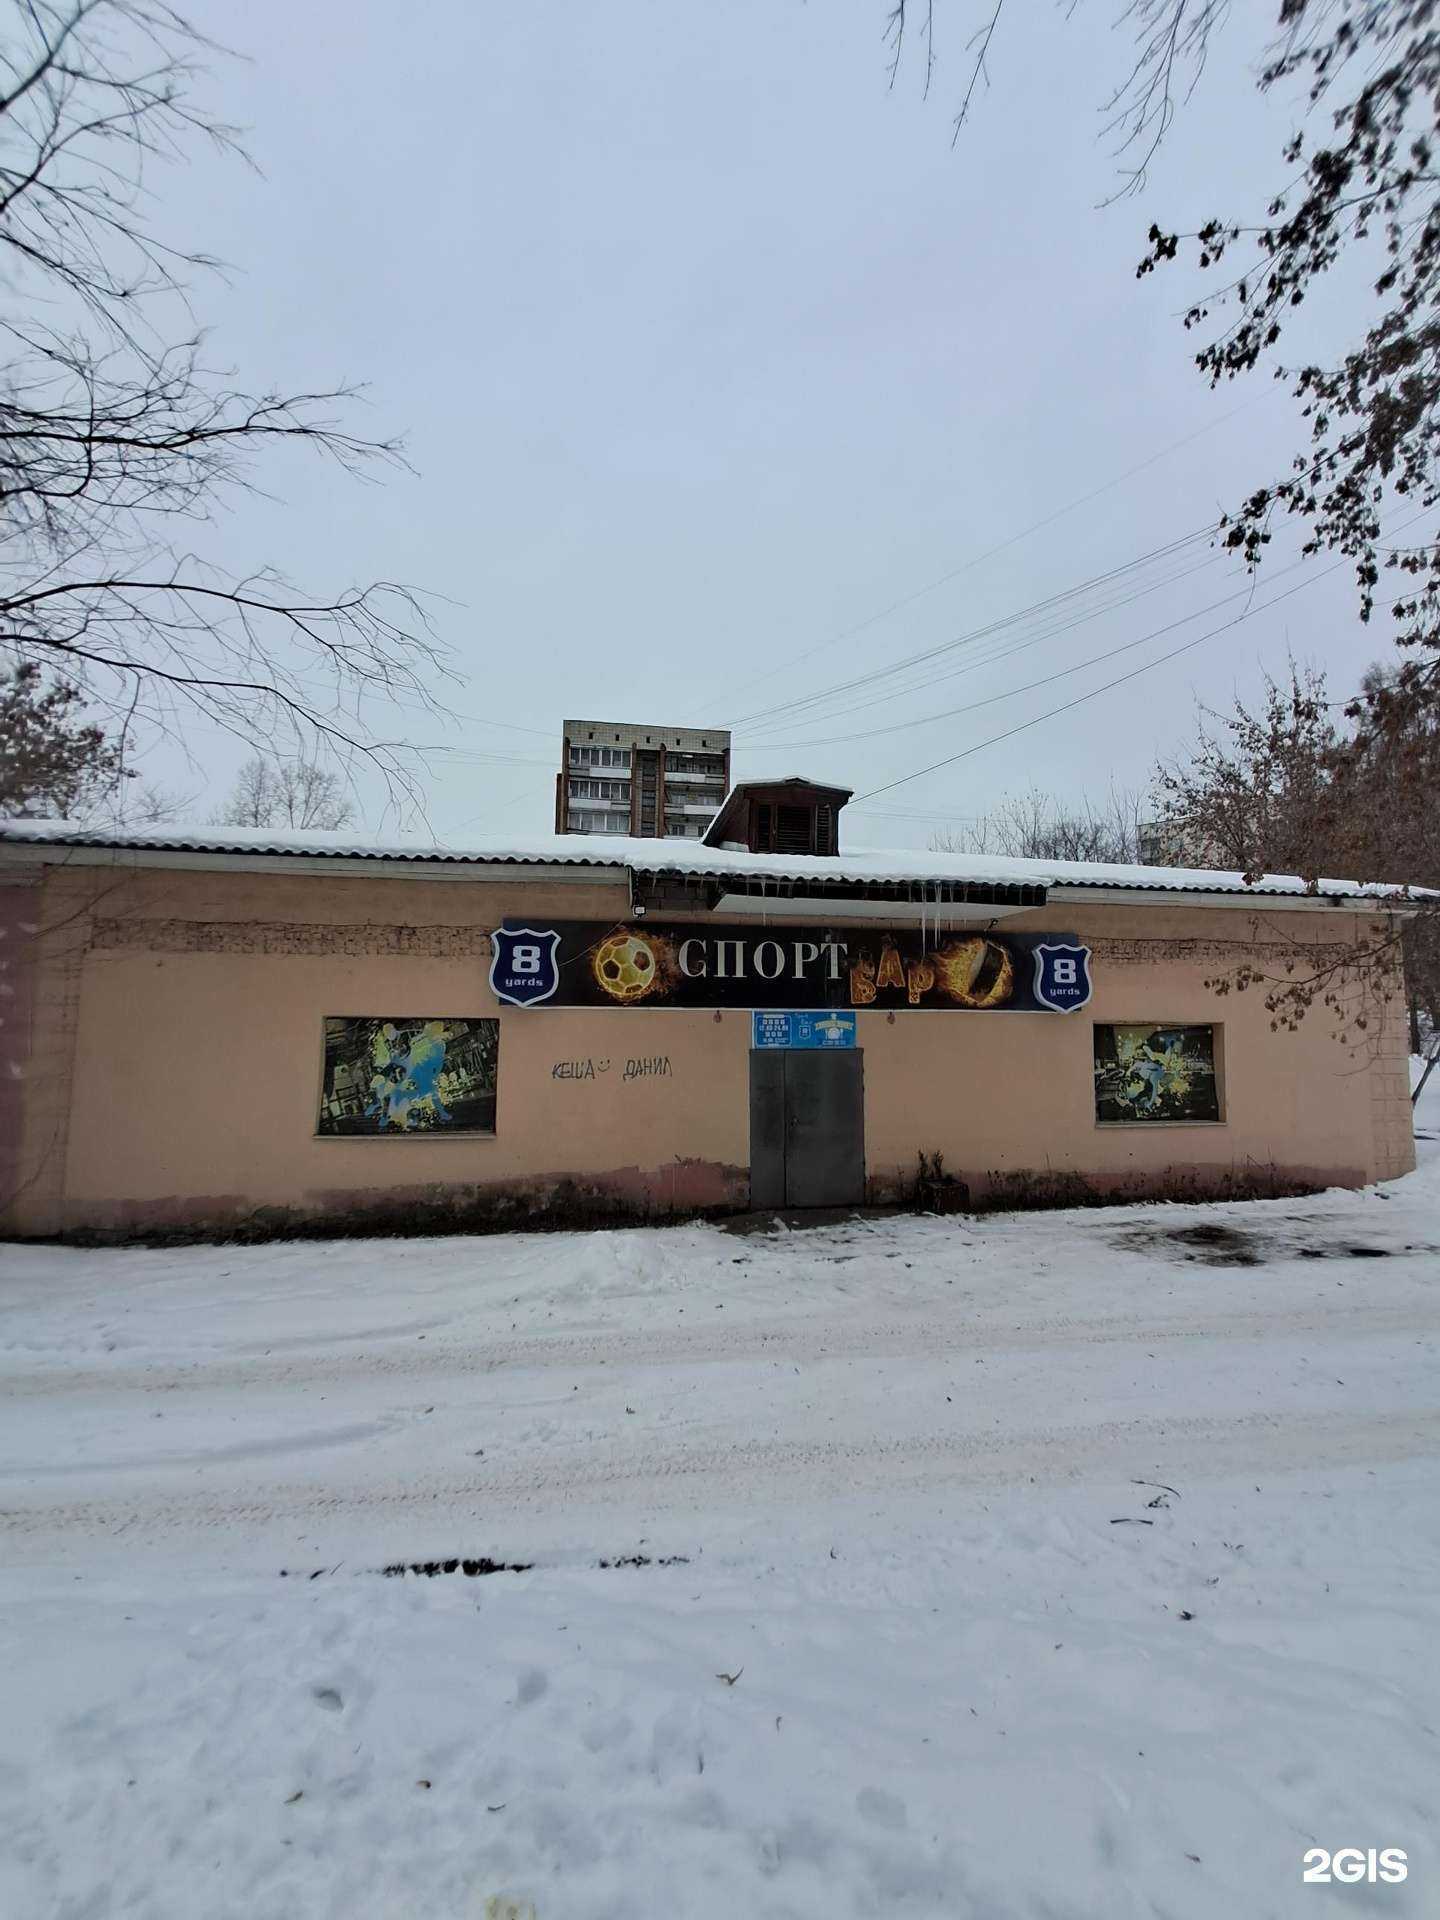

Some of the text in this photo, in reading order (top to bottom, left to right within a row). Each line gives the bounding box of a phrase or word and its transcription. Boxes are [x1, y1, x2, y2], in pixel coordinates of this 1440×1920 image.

[512, 945, 541, 973] 8
[678, 938, 848, 980] СПОРТ
[1053, 958, 1076, 984] 8
[505, 978, 544, 988] yards
[1049, 987, 1081, 997] yards
[551, 1056, 673, 1082] КЕША ДАНИЛ
